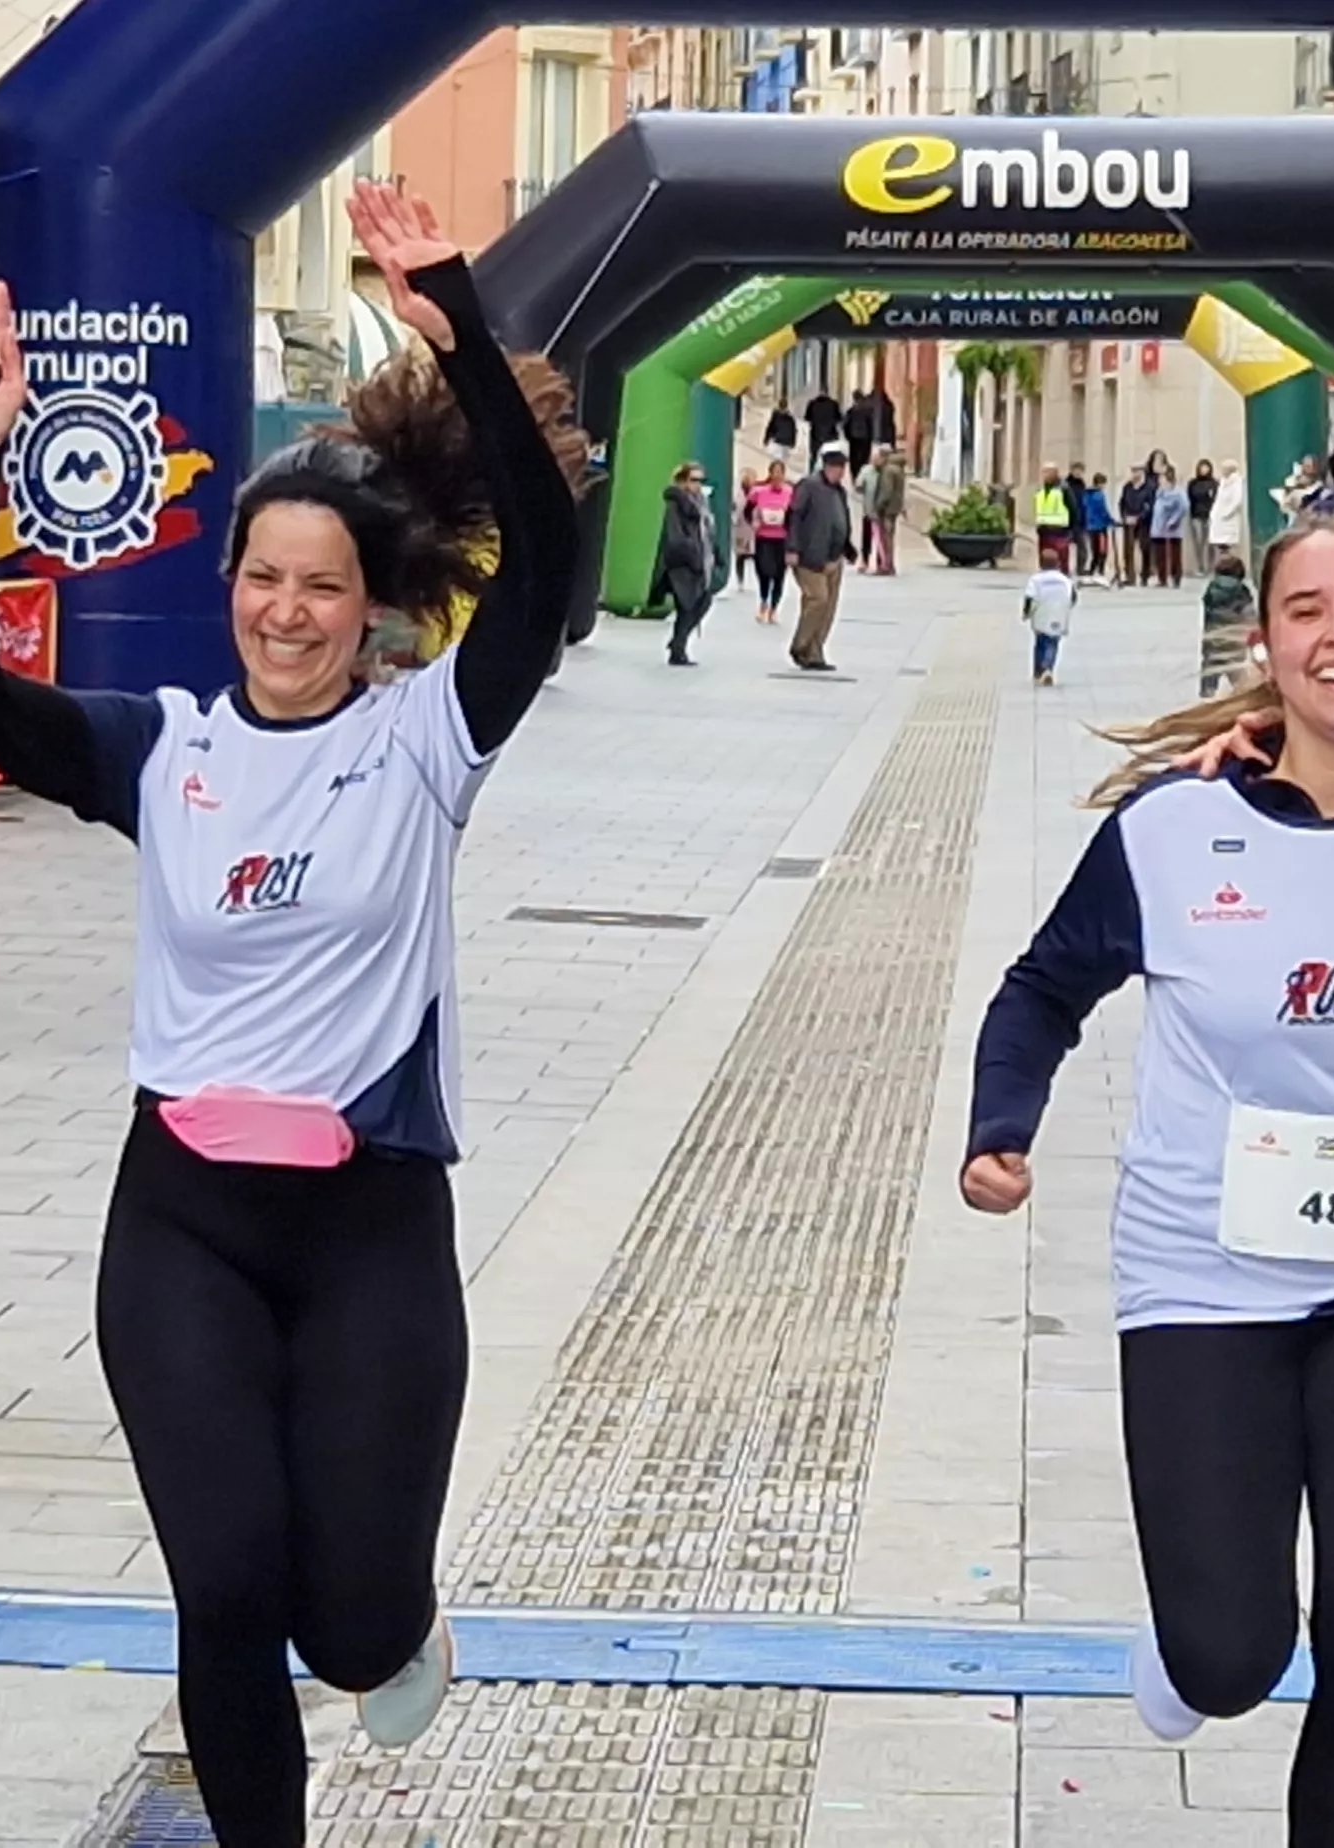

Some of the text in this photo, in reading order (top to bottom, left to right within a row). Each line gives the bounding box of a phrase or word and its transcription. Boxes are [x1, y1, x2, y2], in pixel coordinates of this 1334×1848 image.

[843, 129, 1190, 214] embou
[845, 226, 912, 249] PÁSATE
[914, 231, 928, 249] A
[930, 231, 954, 249] LA
[957, 231, 1070, 249] OPERADORA
[10, 298, 188, 346] undación
[884, 305, 1160, 327] CAJA RURAL DE ARAGÓN
[23, 344, 148, 390] mupol
